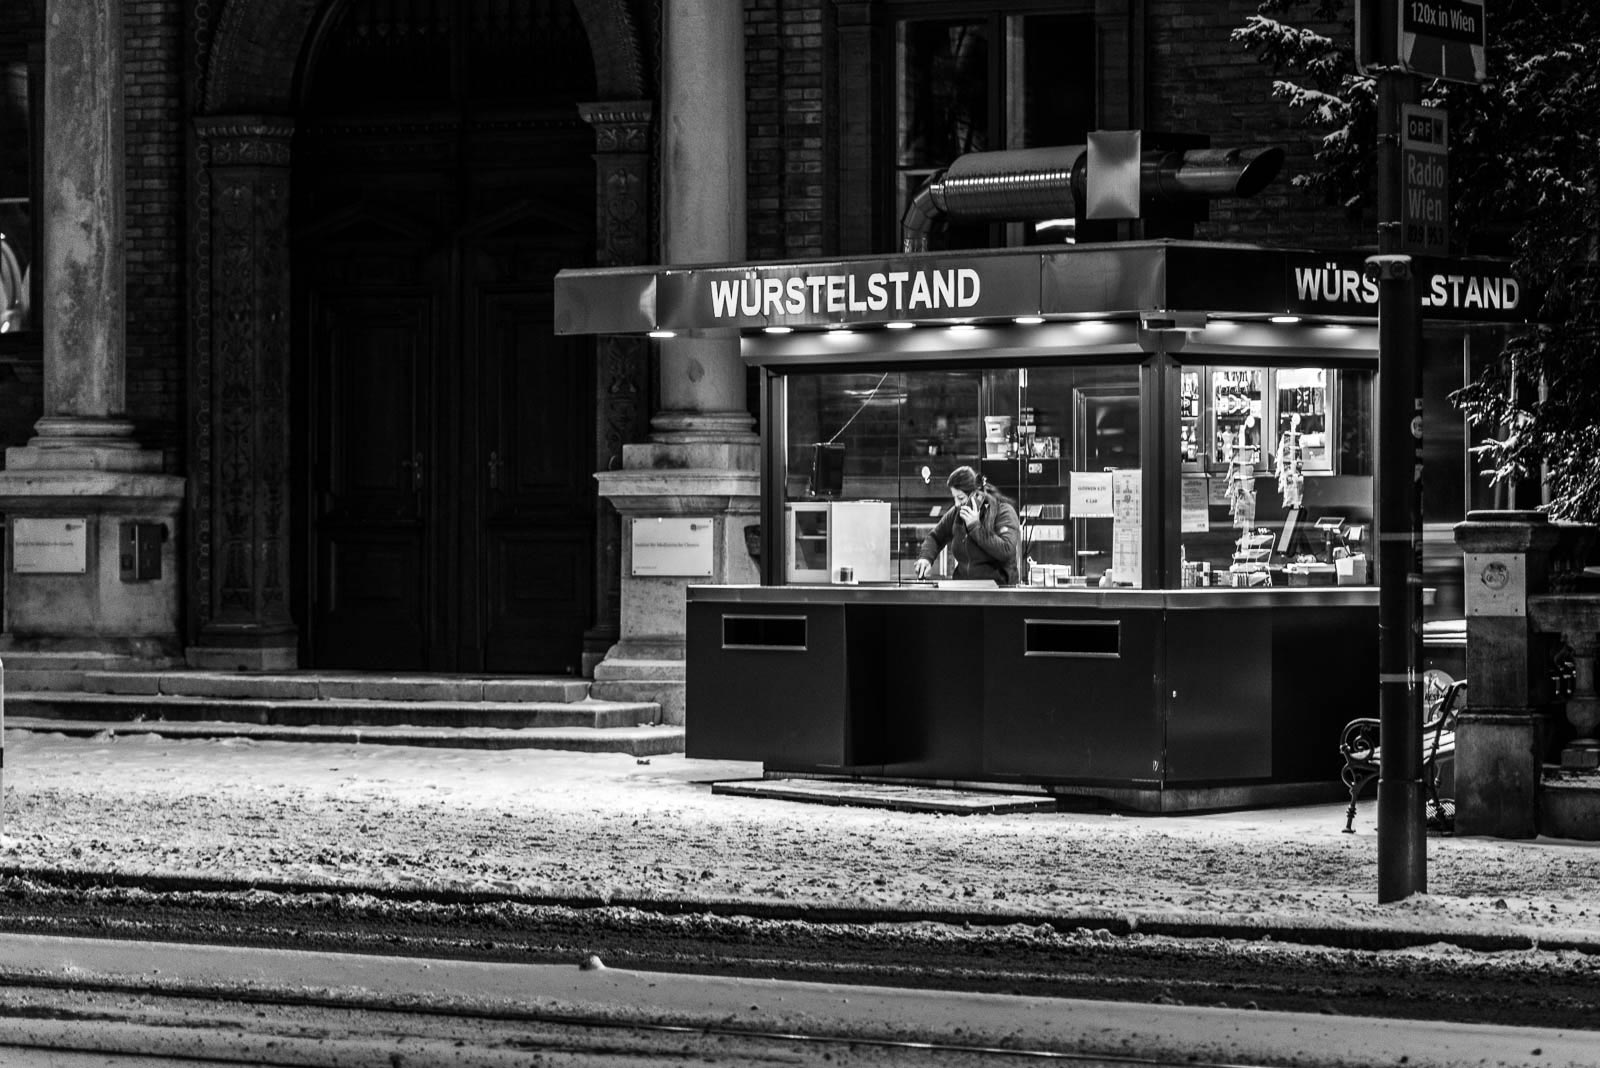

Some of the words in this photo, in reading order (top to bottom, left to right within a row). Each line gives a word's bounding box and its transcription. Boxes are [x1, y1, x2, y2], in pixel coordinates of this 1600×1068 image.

[1411, 2, 1436, 25] 120x
[1438, 5, 1448, 28] in
[1450, 9, 1475, 33] Wien
[1409, 119, 1431, 137] ORF
[1407, 155, 1444, 188] Radio
[1408, 190, 1442, 221] Wien
[710, 268, 981, 318] WÜRSTELSTAND
[1295, 263, 1519, 309] WÜRSSTAND
